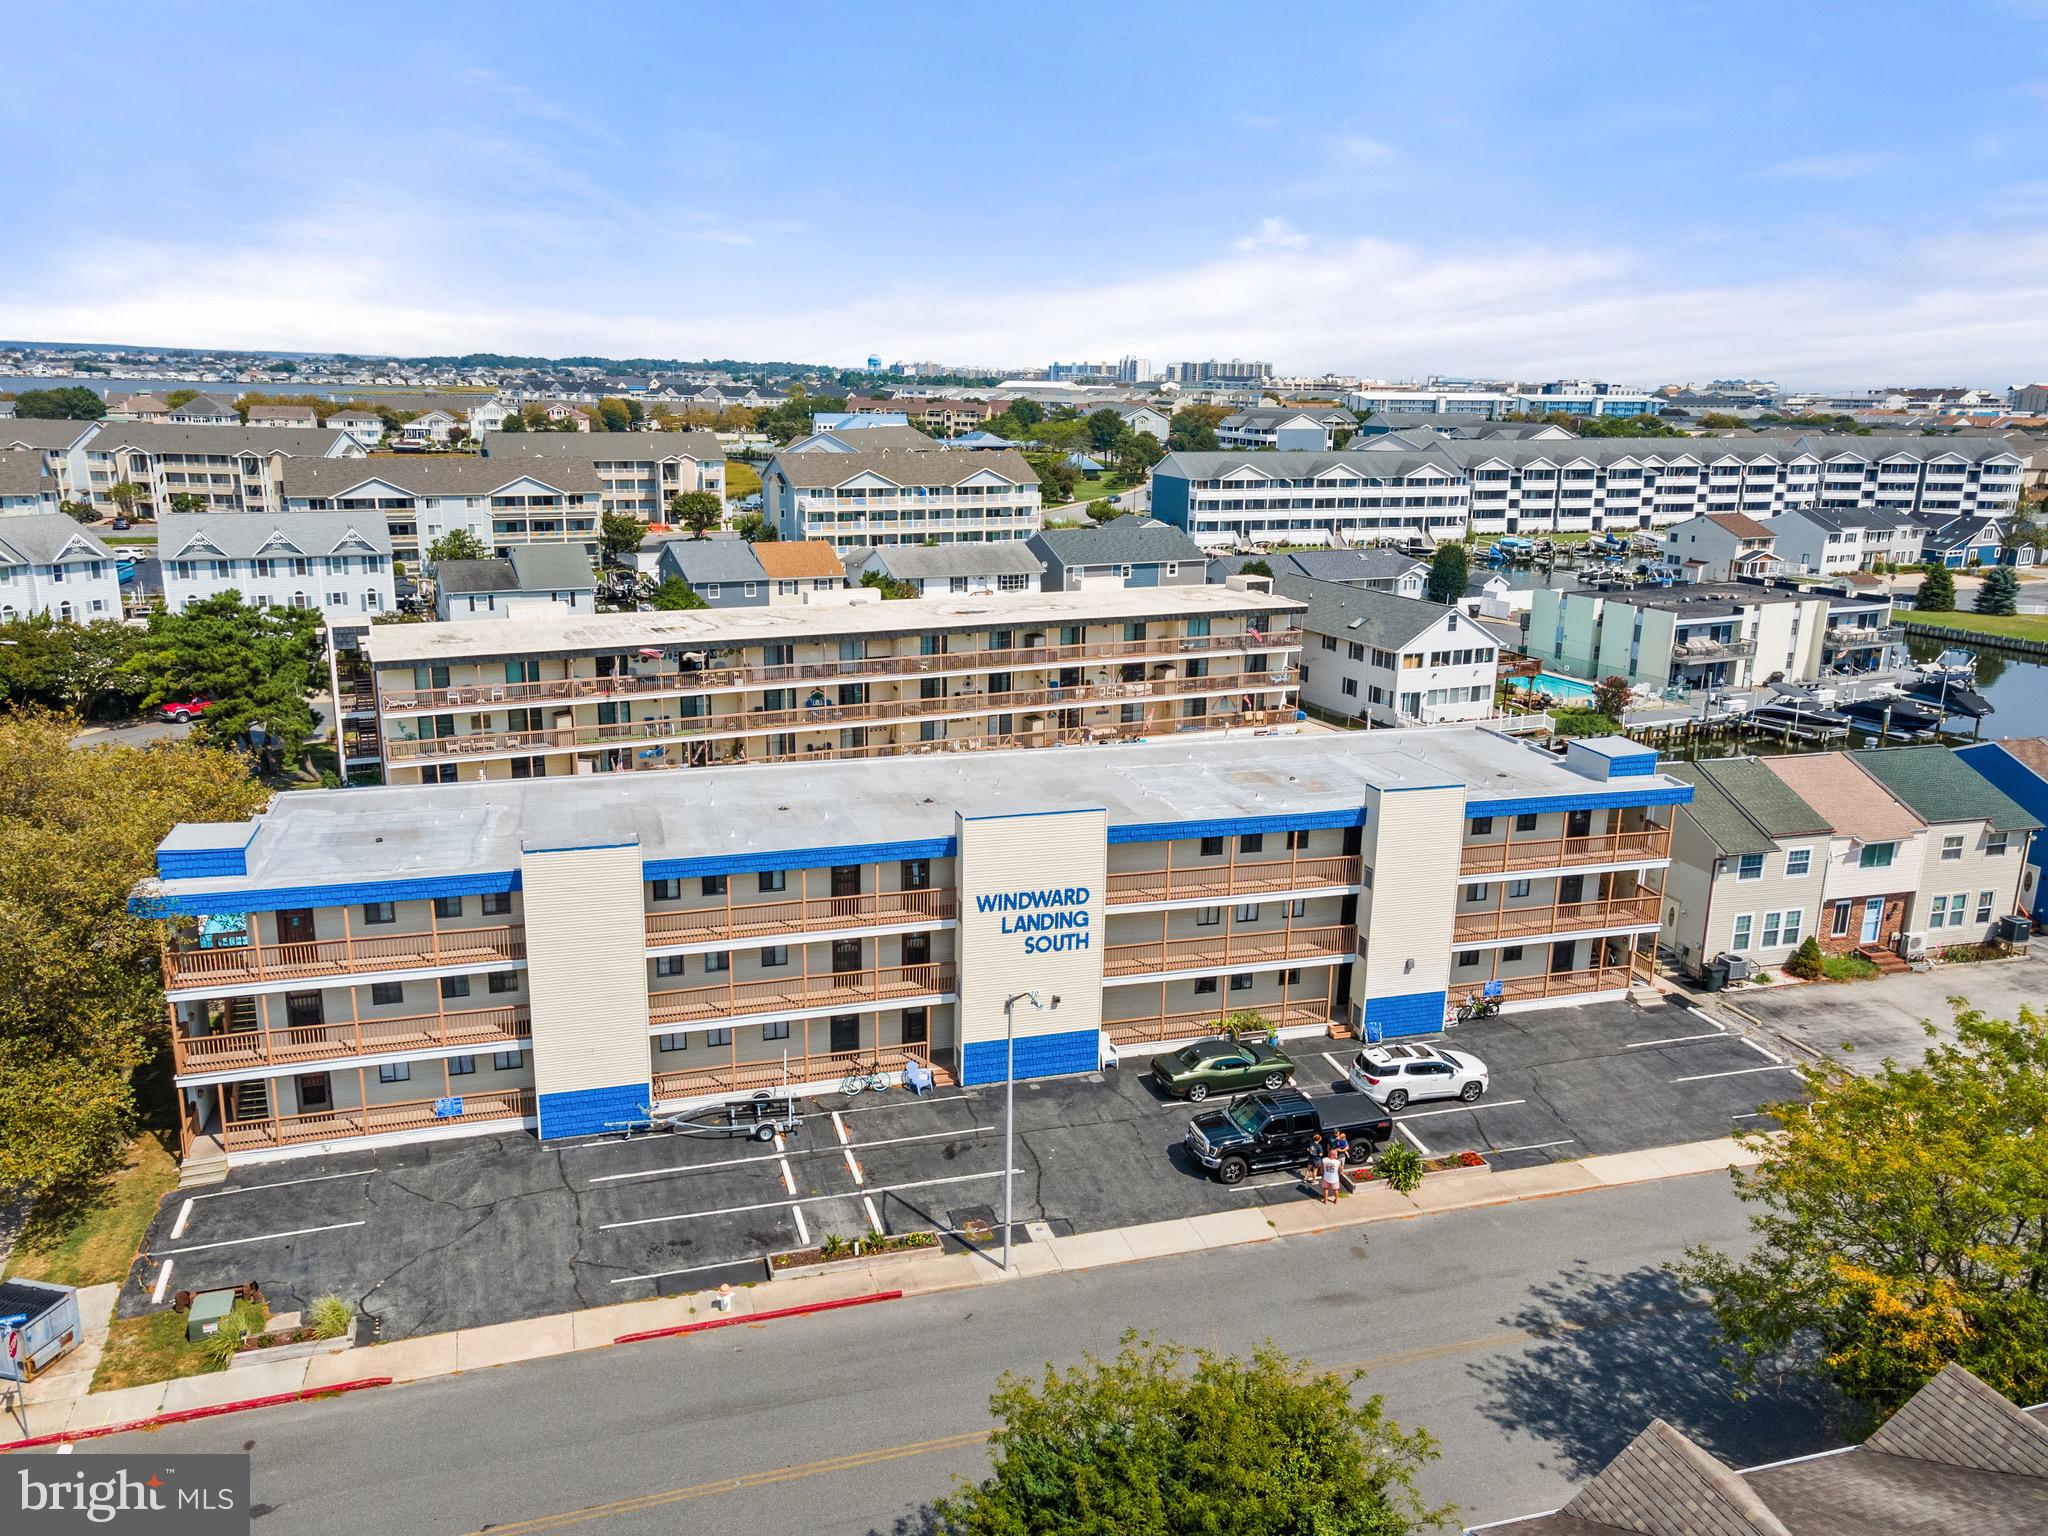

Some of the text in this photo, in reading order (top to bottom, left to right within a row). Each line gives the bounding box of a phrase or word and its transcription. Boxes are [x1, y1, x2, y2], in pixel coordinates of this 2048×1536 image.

[976, 887, 1090, 913] WINDWARD
[1001, 911, 1089, 934] LANDING
[1024, 932, 1089, 954] SOUTH
